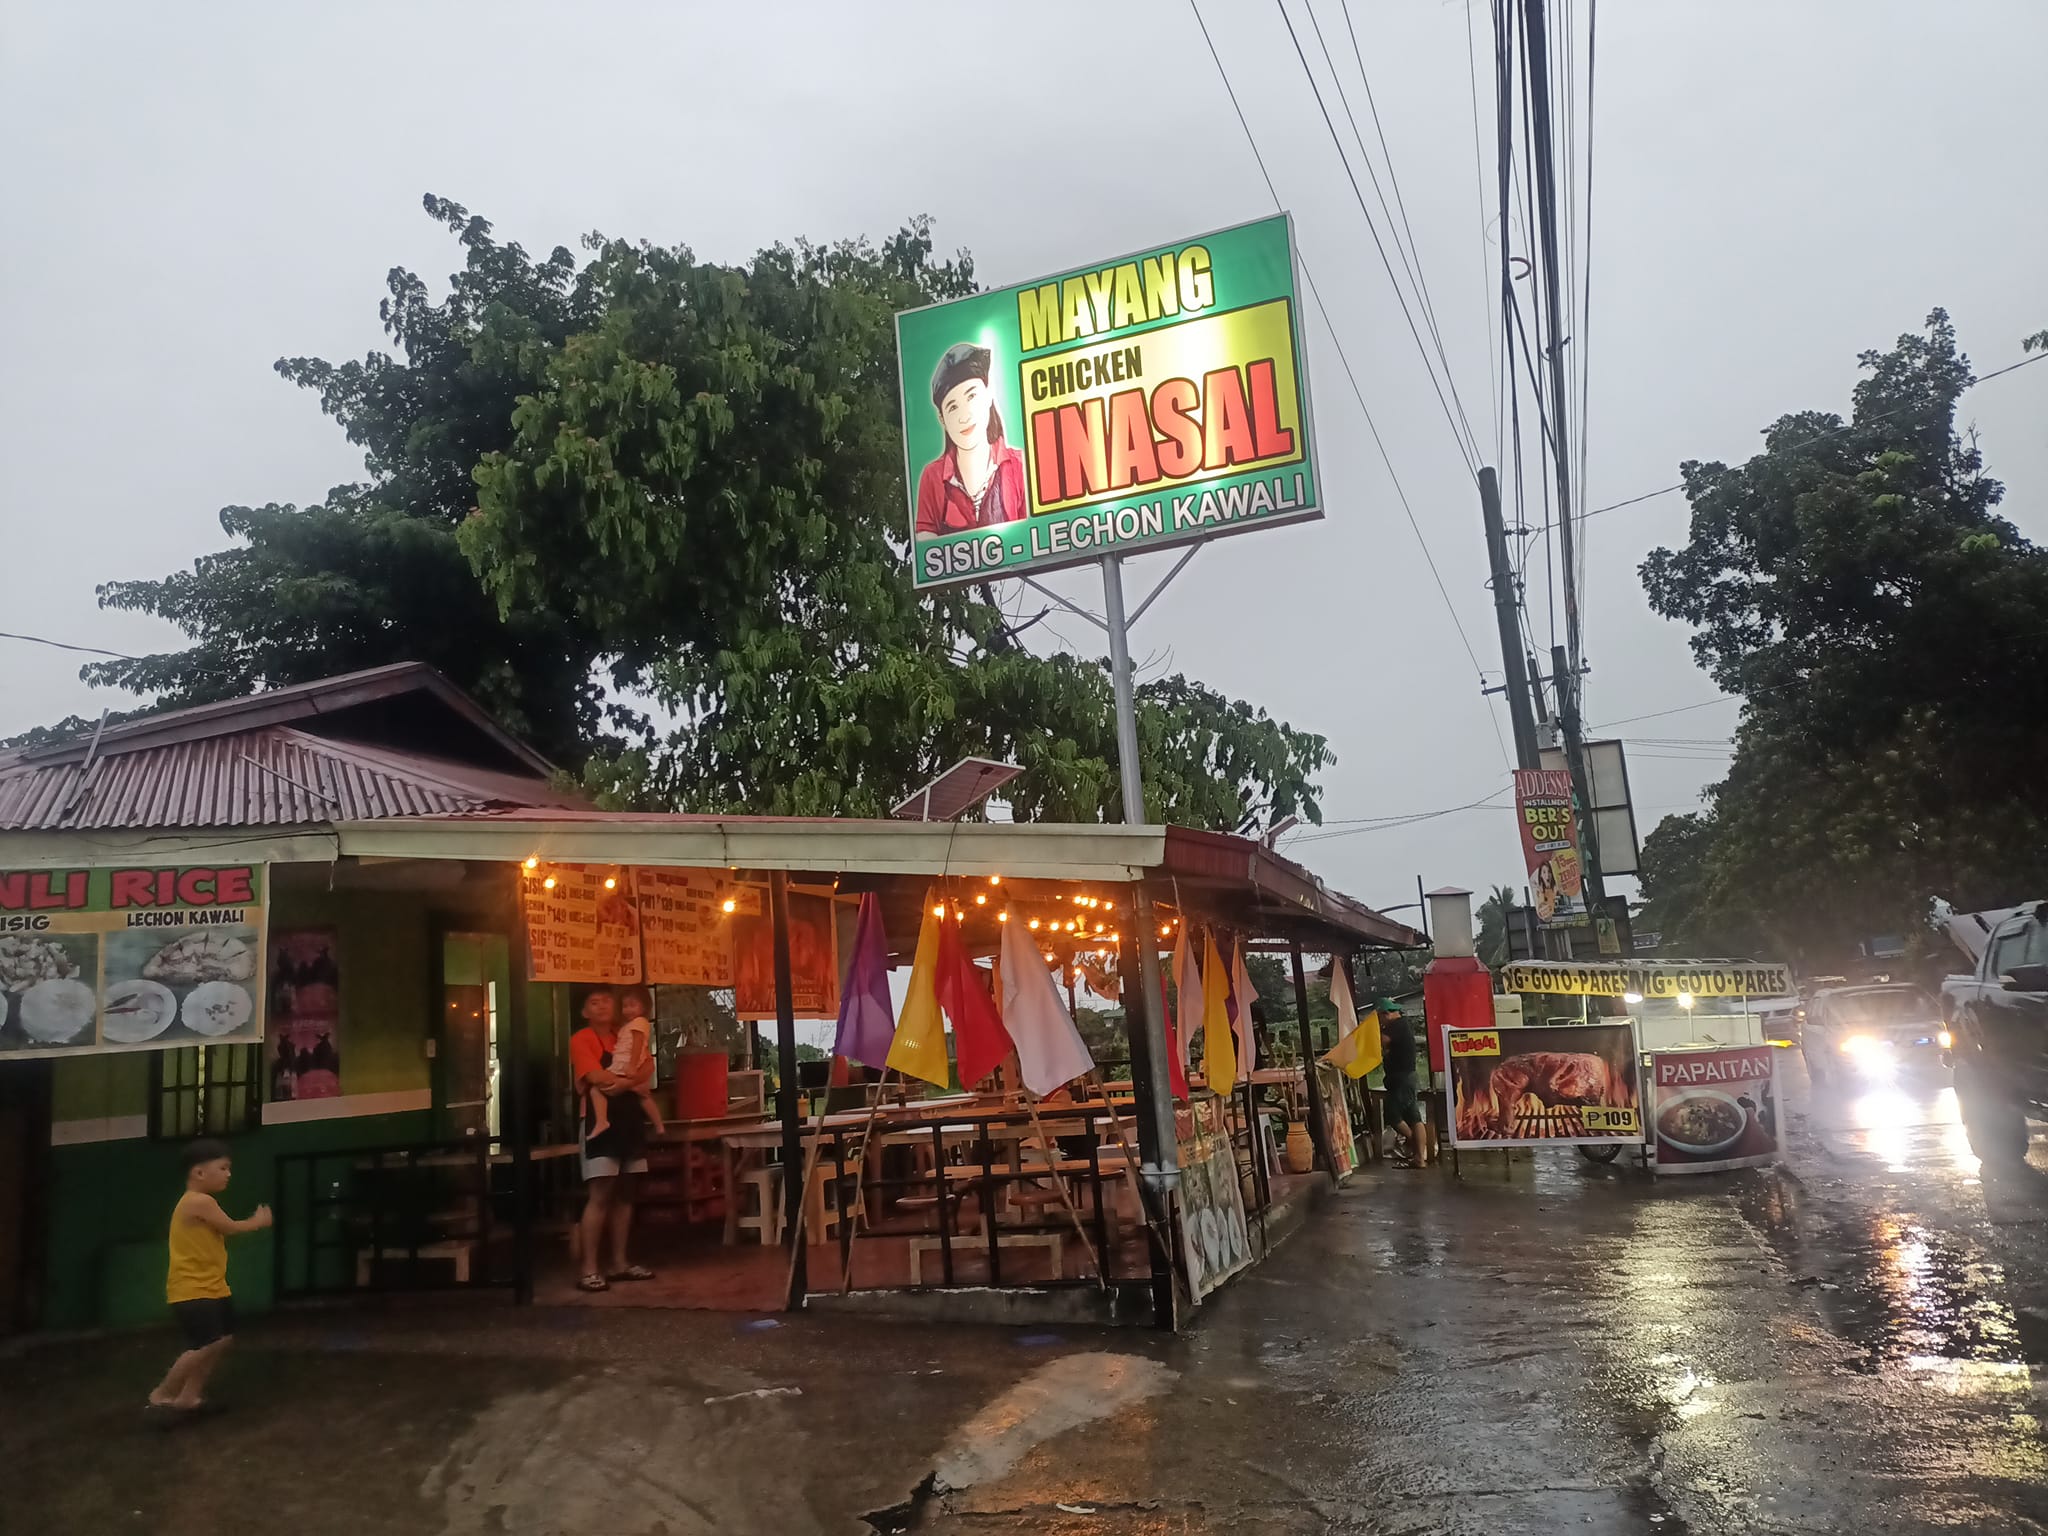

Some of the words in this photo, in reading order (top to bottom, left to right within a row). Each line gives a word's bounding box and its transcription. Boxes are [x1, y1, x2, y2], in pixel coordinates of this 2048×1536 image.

[1018, 245, 1216, 352] MAYANG
[1031, 346, 1143, 401] CHICKEN
[1030, 358, 1296, 505] INASAL
[924, 535, 1003, 578] SISIG
[1030, 503, 1164, 558] LECHON
[1173, 474, 1306, 530] KAWALI
[1516, 771, 1571, 798] ADDESSA
[1524, 807, 1571, 823] BER'S
[1531, 824, 1567, 840] OUT
[111, 866, 254, 909] RICE
[127, 911, 184, 927] LECHON
[188, 909, 244, 925] KAWALI
[1661, 1056, 1770, 1083] PAPAITAN
[1603, 1111, 1632, 1126] 109
